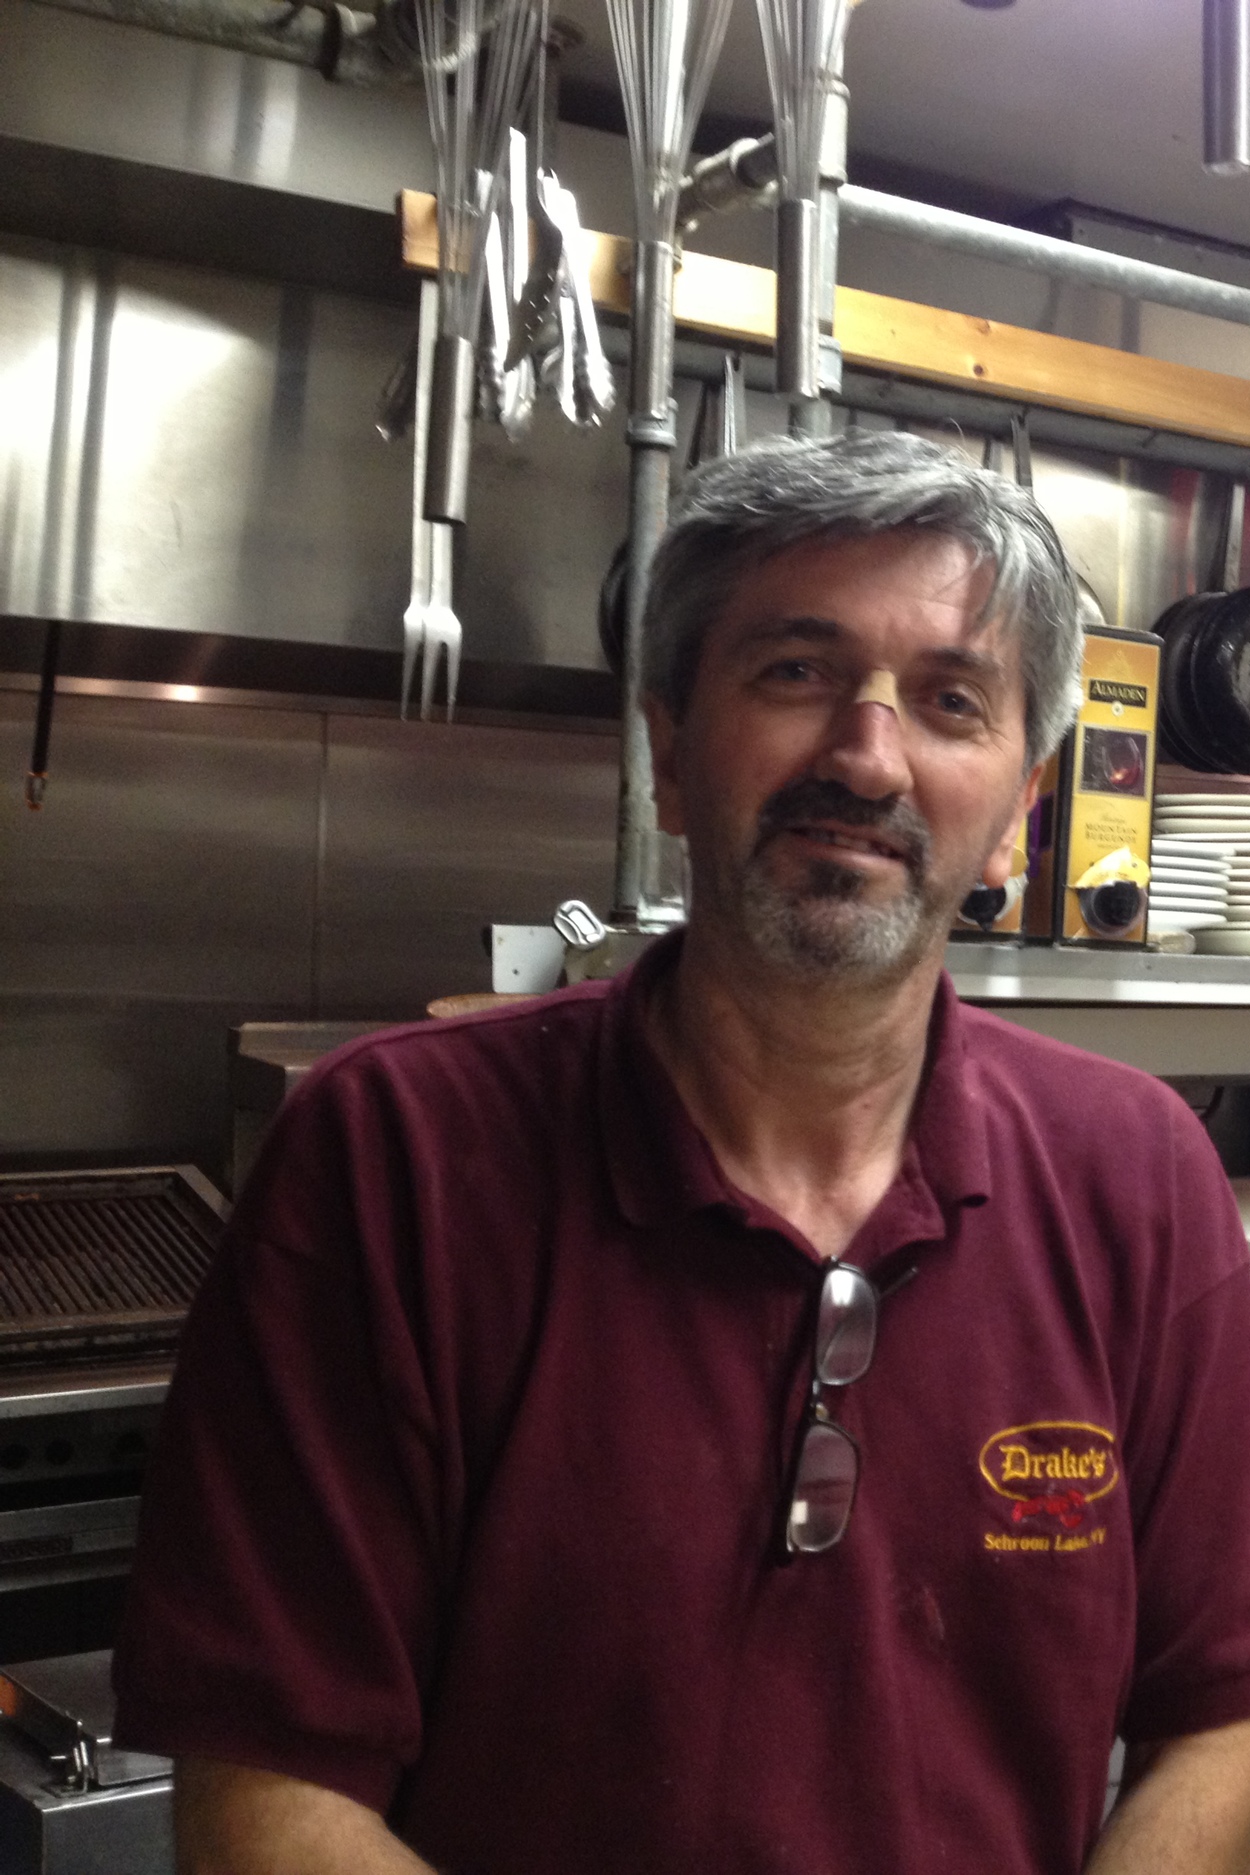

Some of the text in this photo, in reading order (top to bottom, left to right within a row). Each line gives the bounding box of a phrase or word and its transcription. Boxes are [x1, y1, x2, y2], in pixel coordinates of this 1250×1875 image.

[1091, 680, 1145, 702] ALMADEN
[1000, 1444, 1107, 1482] Drake's
[984, 1532, 1049, 1550] Schroon
